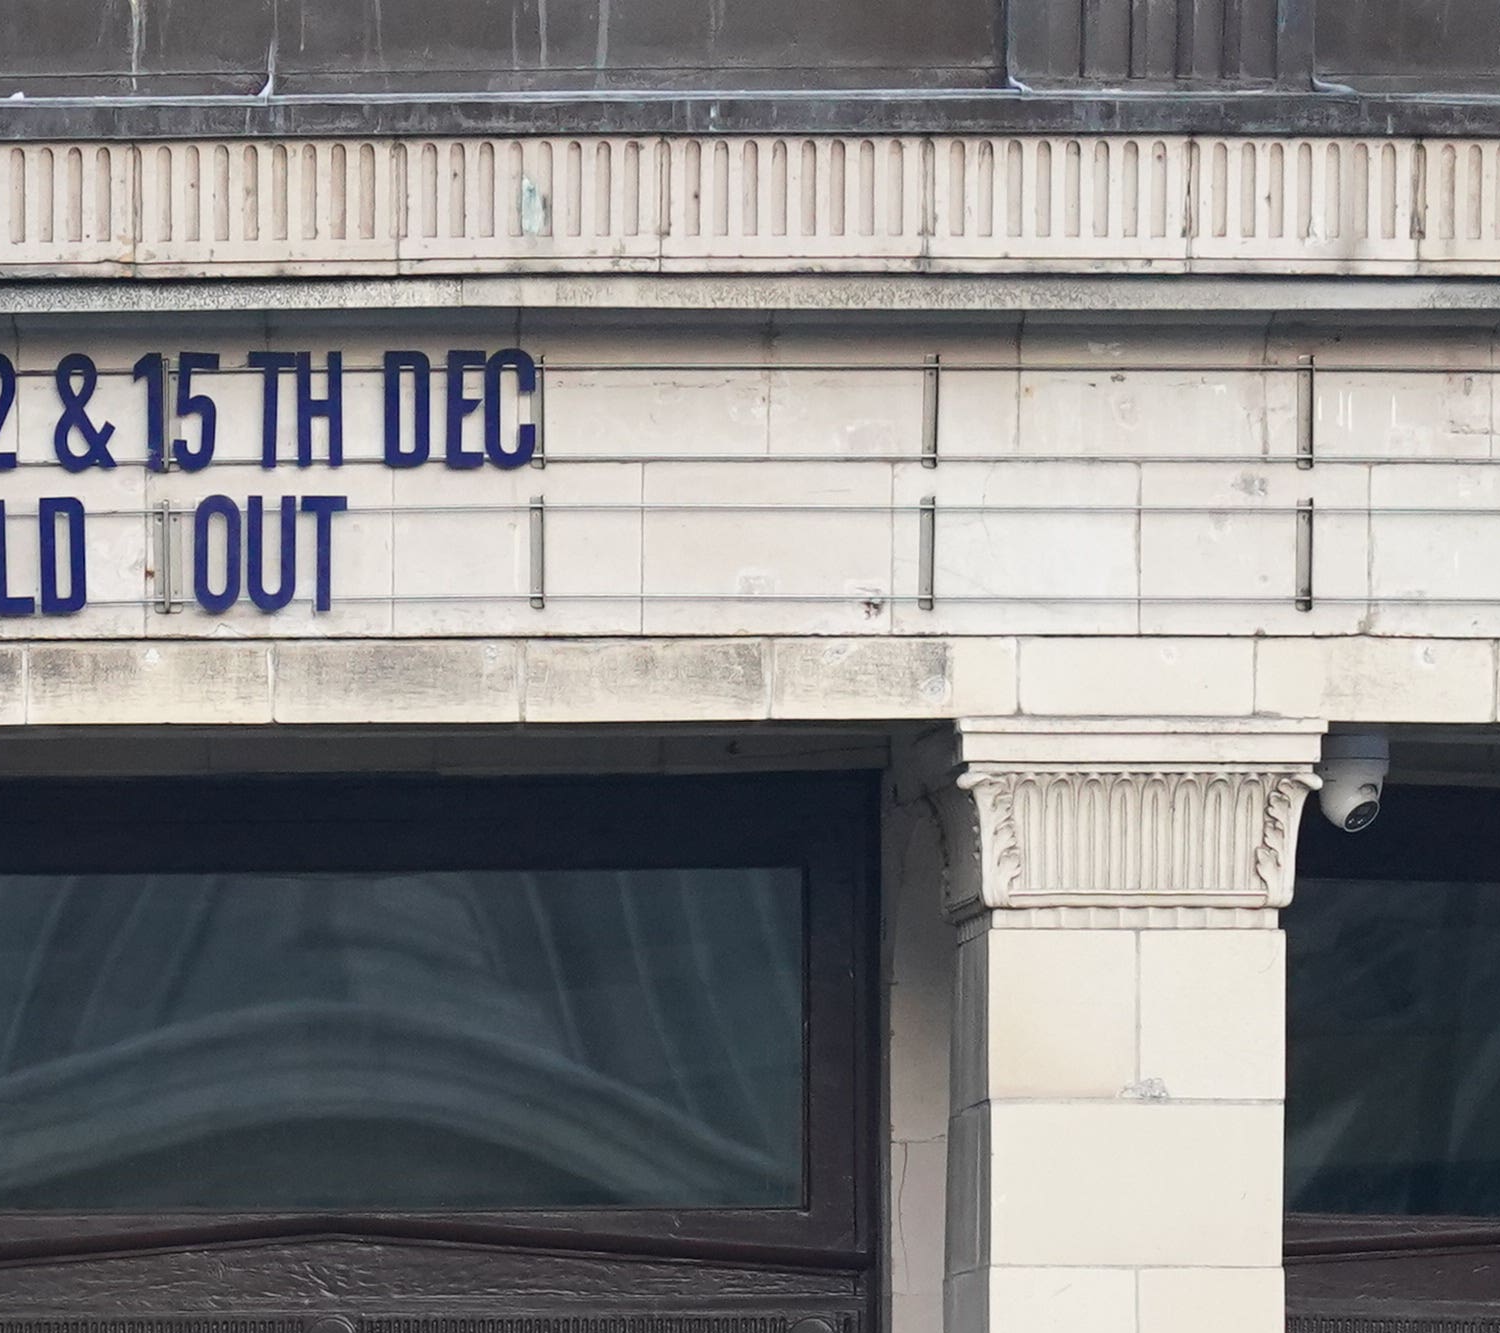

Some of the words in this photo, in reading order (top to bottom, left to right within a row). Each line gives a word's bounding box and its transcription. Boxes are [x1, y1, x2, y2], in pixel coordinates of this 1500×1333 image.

[53, 352, 118, 473] &
[384, 349, 536, 470] DEC
[193, 494, 348, 614] OUT
